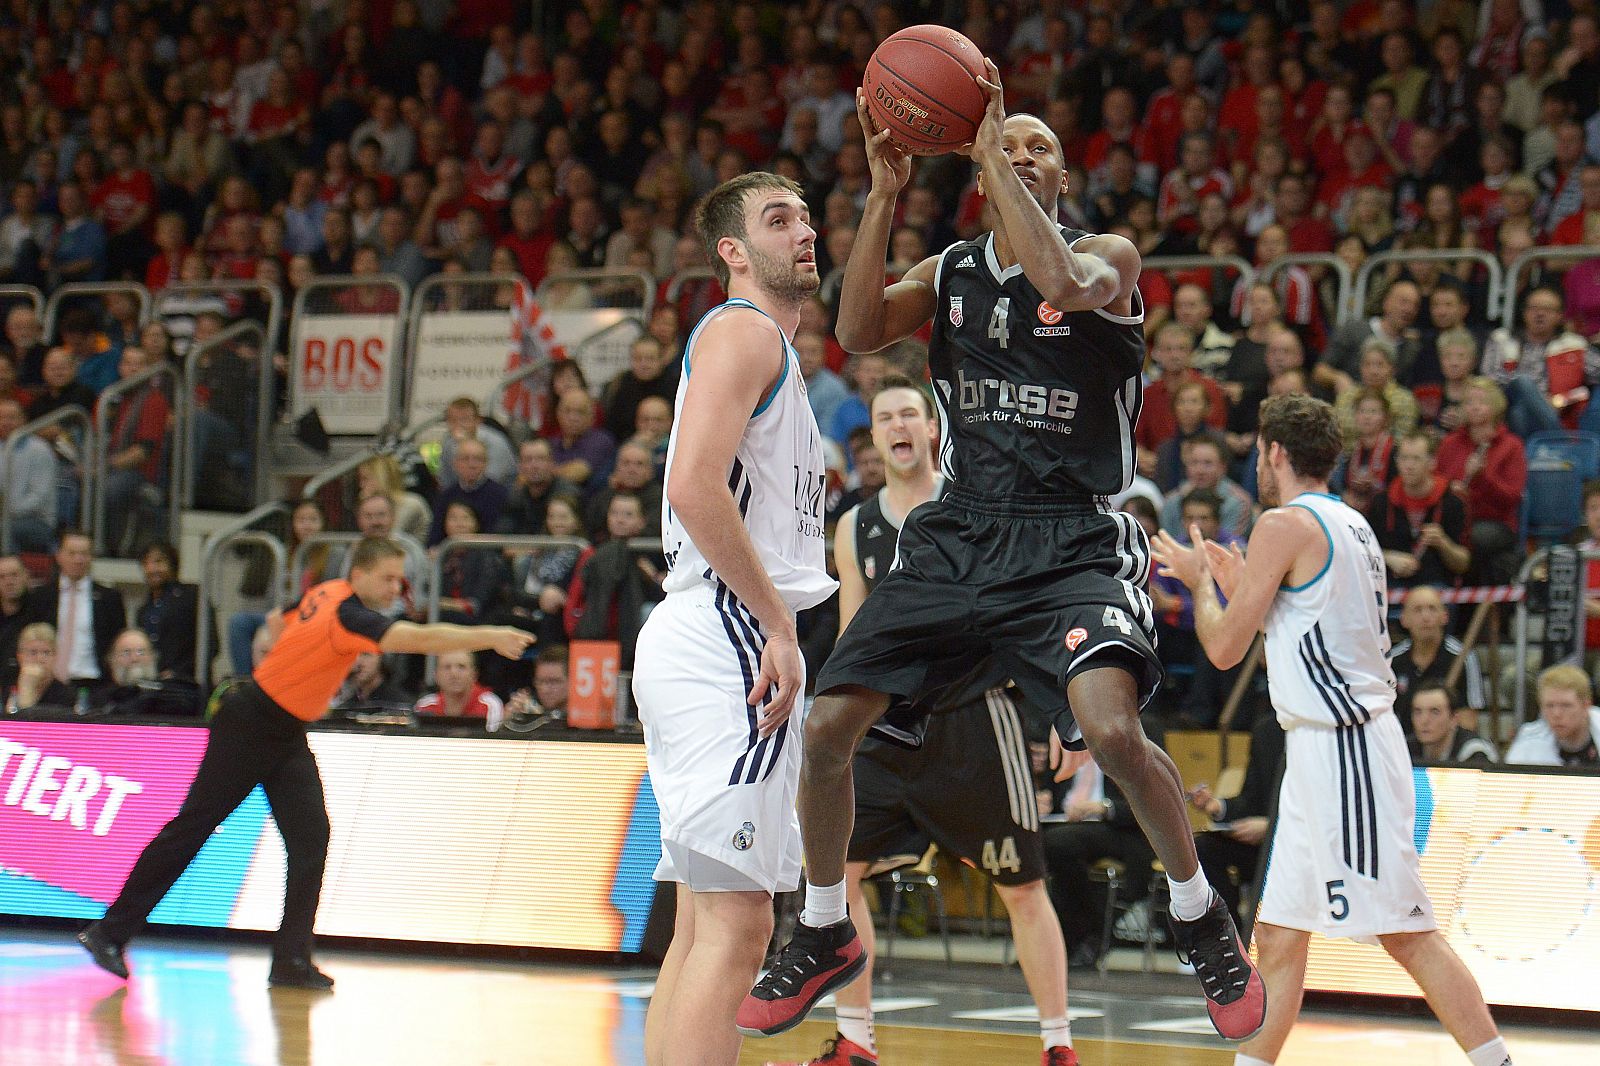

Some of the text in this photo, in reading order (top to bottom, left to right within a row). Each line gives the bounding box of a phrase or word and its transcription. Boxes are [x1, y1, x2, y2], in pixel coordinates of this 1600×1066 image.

[876, 87, 946, 138] TF-1000
[897, 98, 929, 118] LEGACY
[987, 297, 1011, 349] 4
[303, 336, 385, 394] BOS
[957, 369, 1079, 420] brose
[991, 410, 1011, 421] für
[1101, 605, 1133, 636] 4
[981, 836, 1022, 876] 44
[1325, 879, 1350, 920] 5
